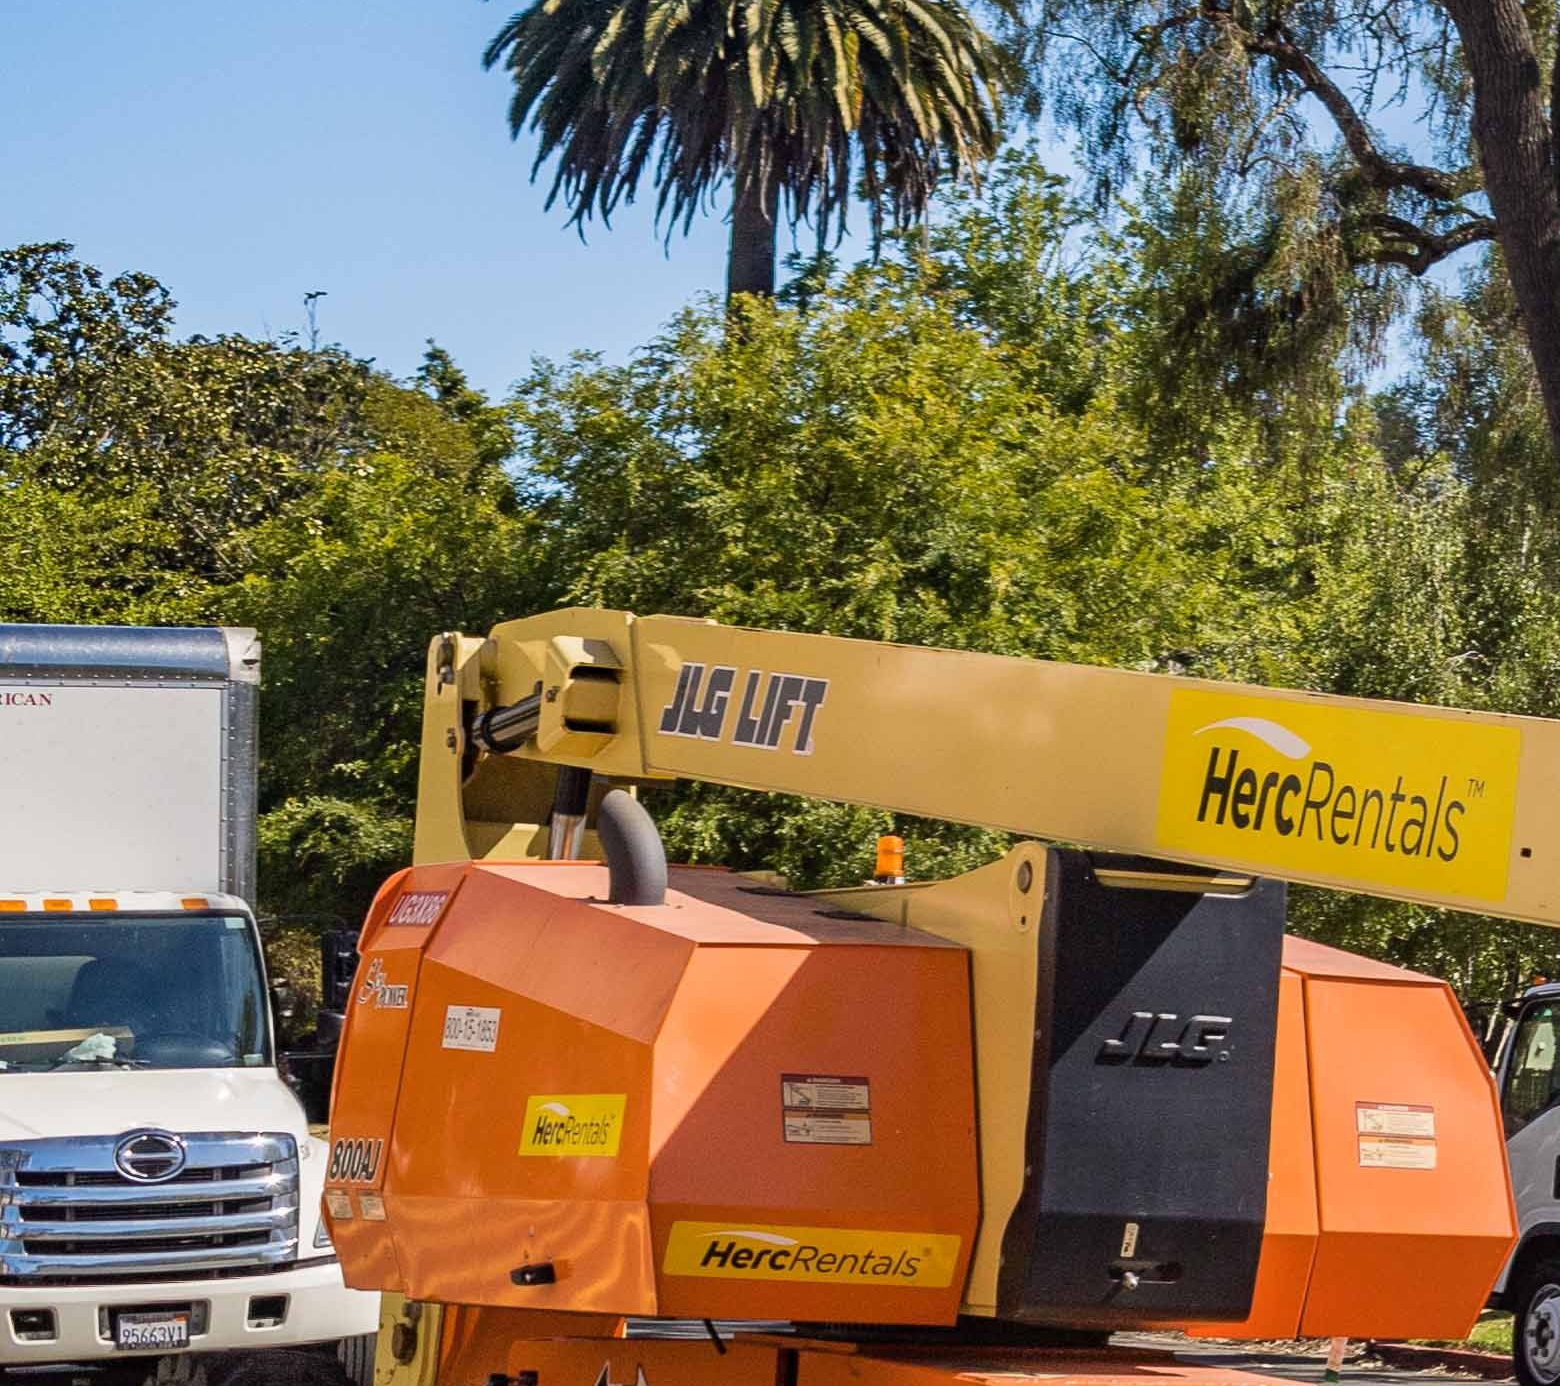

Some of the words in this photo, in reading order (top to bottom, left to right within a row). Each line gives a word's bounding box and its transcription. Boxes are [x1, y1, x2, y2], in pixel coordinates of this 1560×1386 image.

[0, 692, 53, 707] ICAN
[657, 661, 738, 742] JLG
[730, 669, 830, 757] LIFT
[1196, 746, 1466, 862] HercRentals
[532, 1114, 610, 1146] HercRentals
[328, 1138, 384, 1184] 800AJ
[699, 1240, 921, 1278] HercRentals
